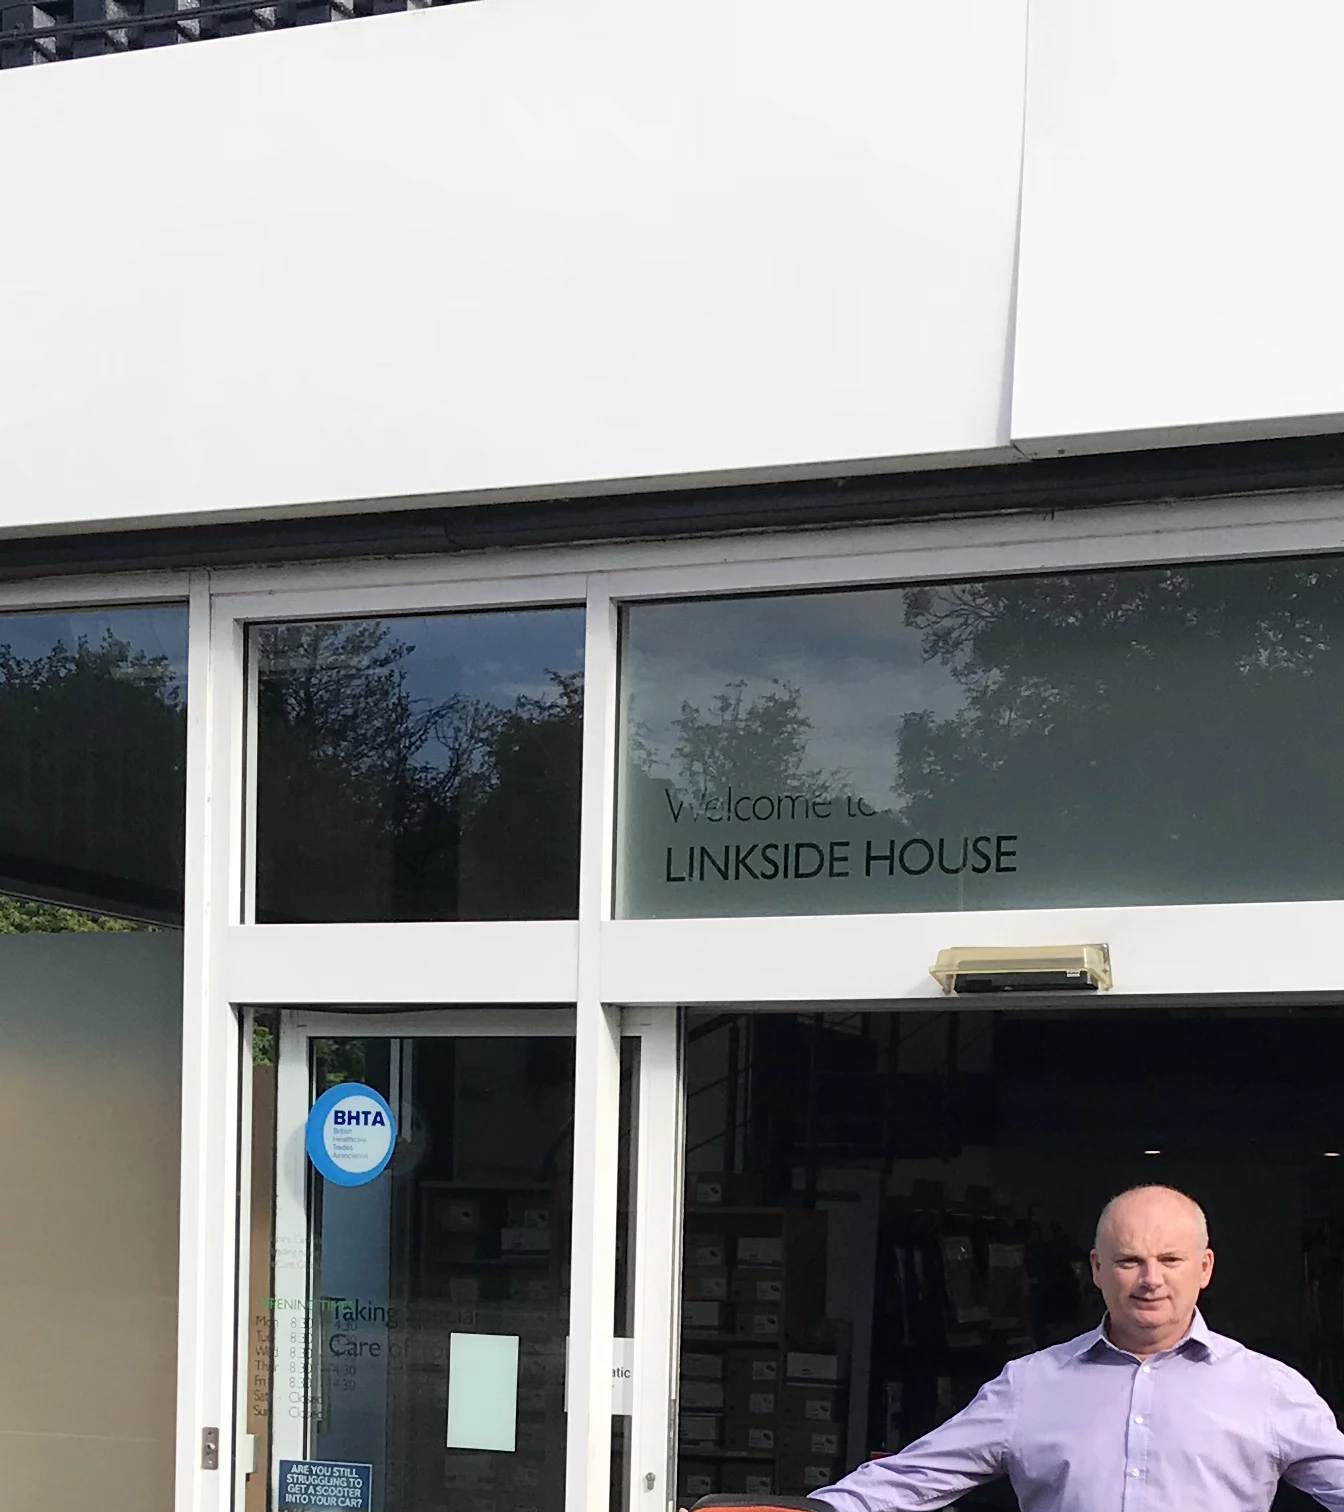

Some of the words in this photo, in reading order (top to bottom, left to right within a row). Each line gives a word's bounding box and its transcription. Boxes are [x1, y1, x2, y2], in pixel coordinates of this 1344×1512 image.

[666, 840, 850, 883] LINKSIDE
[864, 834, 1018, 877] HOUSE
[333, 1110, 385, 1126] BHTA
[326, 1297, 398, 1328] Taking
[329, 1333, 381, 1357] Care
[290, 1464, 309, 1475] ARE
[311, 1465, 331, 1476] YOU
[333, 1467, 359, 1478] STILL
[286, 1474, 347, 1488] STRUGGLING
[349, 1478, 363, 1489] TO
[287, 1483, 306, 1494] GET
[308, 1485, 315, 1494] A
[316, 1486, 361, 1498] SCOOTER
[285, 1494, 309, 1504] INTO
[310, 1495, 337, 1506] YOUR
[338, 1497, 363, 1508] CAR?
